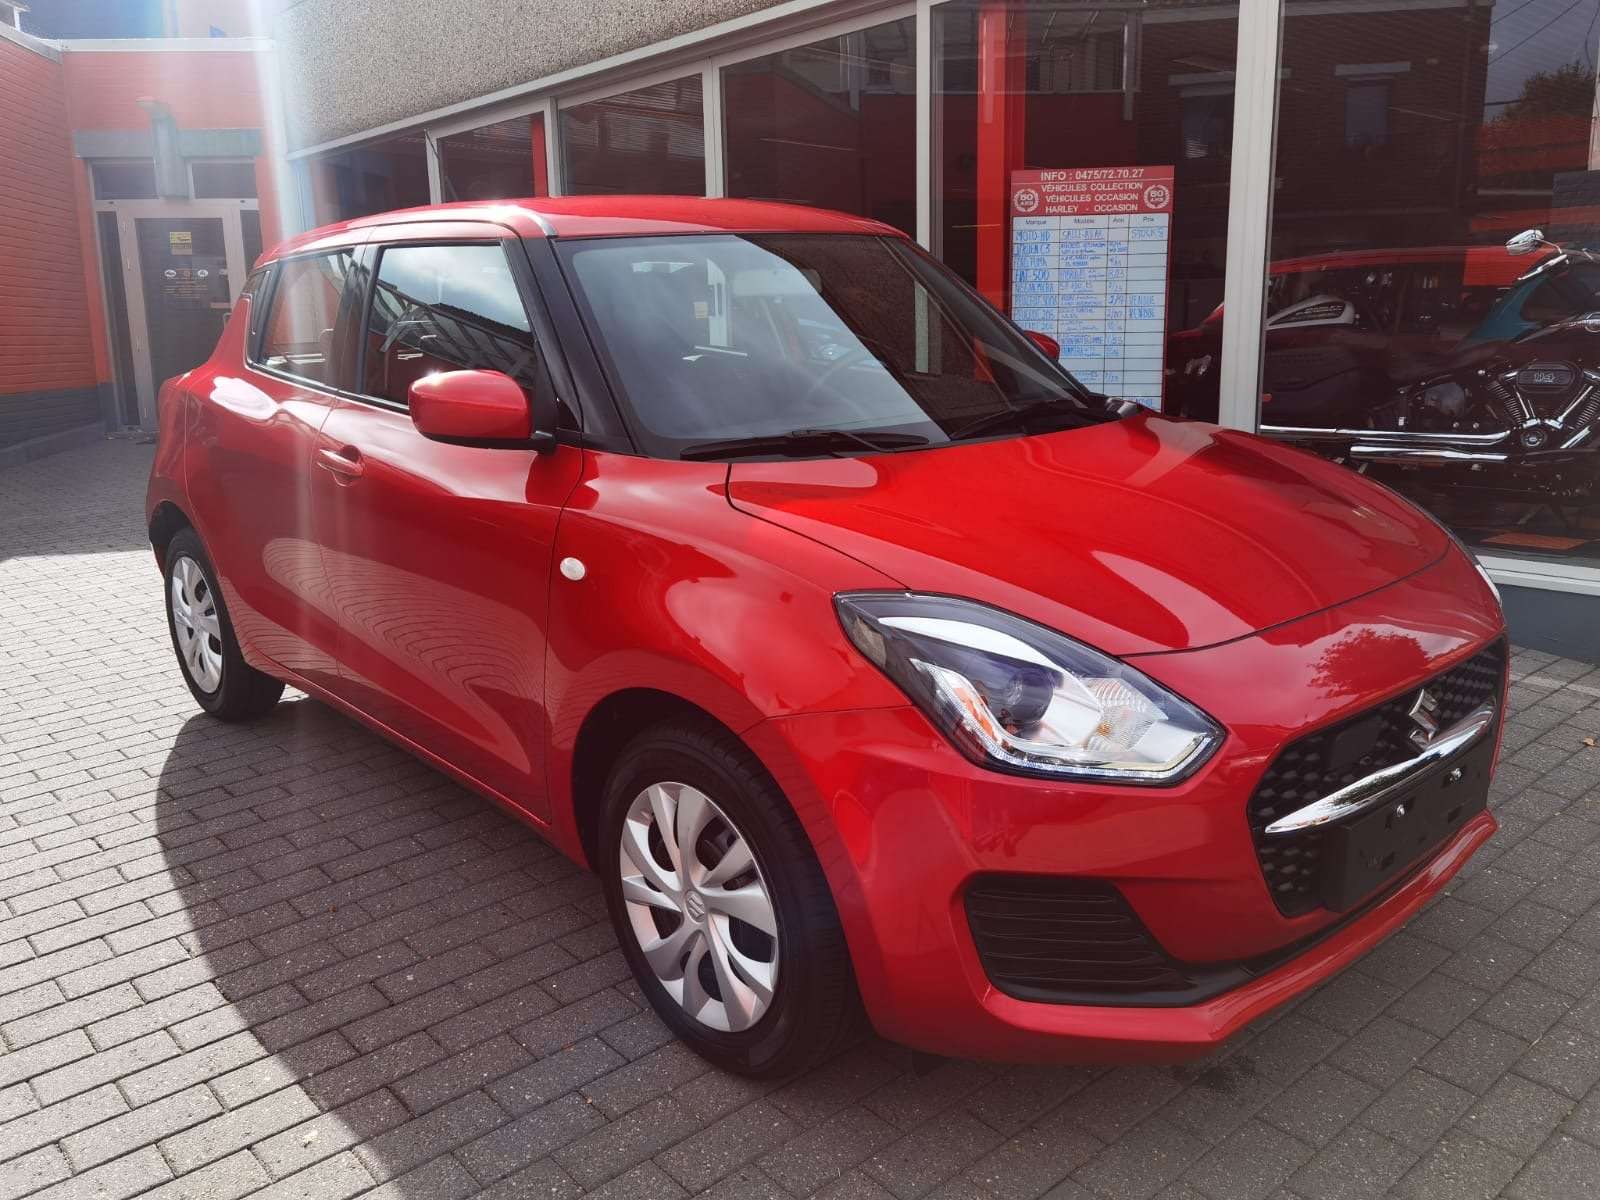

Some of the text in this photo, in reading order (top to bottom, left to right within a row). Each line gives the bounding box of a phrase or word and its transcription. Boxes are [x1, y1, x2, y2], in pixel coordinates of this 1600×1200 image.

[1040, 171, 1066, 181] INFO
[1075, 168, 1145, 180] 0475/72.70.27
[1090, 182, 1143, 191] COLLECTION
[1094, 192, 1139, 202] OCCASION
[1045, 205, 1078, 213] HARLEY
[1094, 203, 1138, 212] OCCASION
